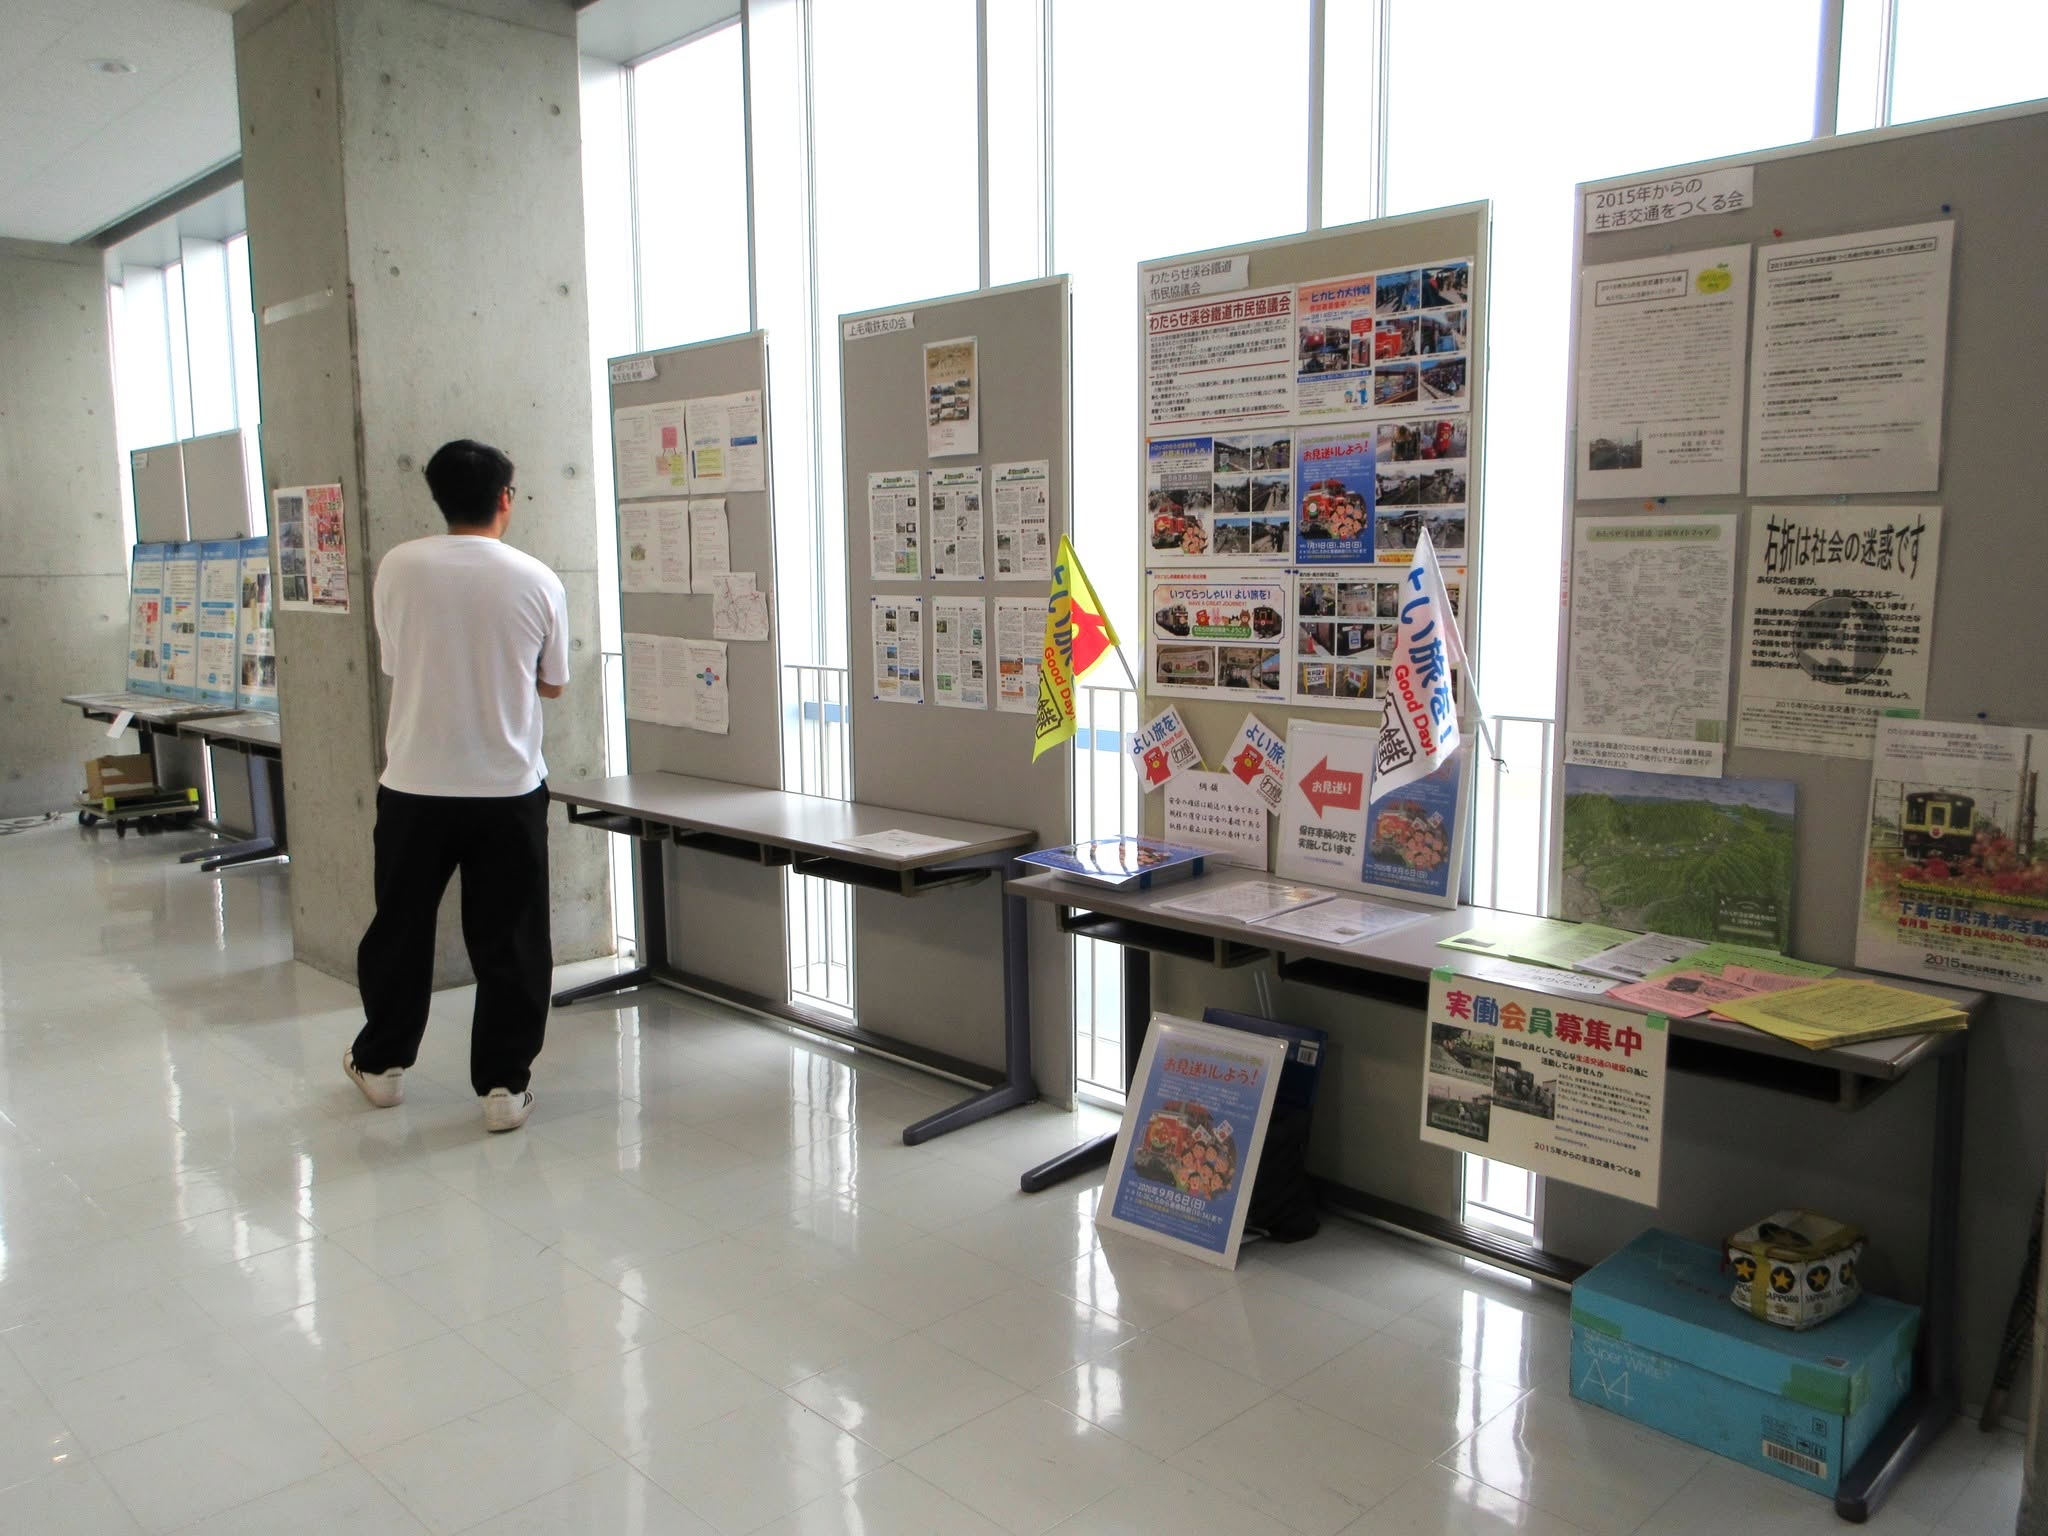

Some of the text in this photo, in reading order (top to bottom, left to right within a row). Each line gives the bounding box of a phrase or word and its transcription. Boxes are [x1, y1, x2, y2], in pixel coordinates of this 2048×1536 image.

[1594, 191, 1744, 229] 生活交通をつくる会
[1596, 178, 1703, 209] 2015年からの
[1150, 259, 1232, 286] わたらせ渓谷鐵道
[1150, 281, 1201, 301] 市民協議会
[848, 317, 907, 337] 上毛電鉄友の会
[1149, 295, 1291, 331] わたらせ渓谷鐵道市民協議会
[1303, 440, 1369, 461] お見送りしよう!
[1765, 513, 1927, 580] 右折は社会の迷惑です
[1234, 589, 1271, 600] よい旅を!
[1044, 647, 1077, 721] Good Day!
[1394, 664, 1438, 756] Good Day!
[1133, 711, 1181, 756] よい旅を!
[1245, 724, 1286, 769] よい旅
[1311, 780, 1351, 795] お見送り
[1445, 990, 1643, 1057] 実働会員募集中
[1163, 1056, 1261, 1086] お見送りしよう!
[1540, 1057, 1604, 1079] 活動してみませんか
[1534, 1141, 1642, 1179] 2015年からの生活交通をつくる会
[1767, 1293, 1799, 1304] APPORO
[1577, 1358, 1635, 1408] A4
